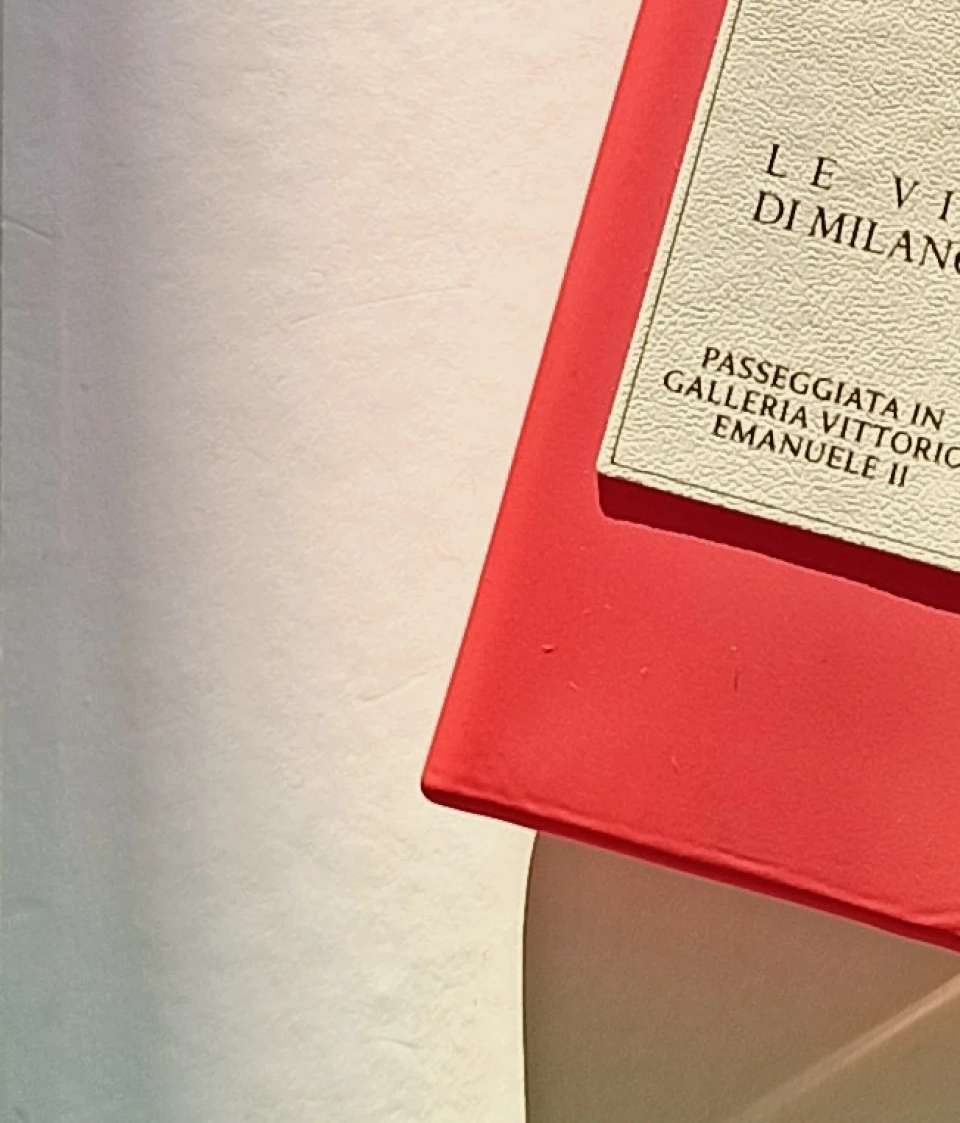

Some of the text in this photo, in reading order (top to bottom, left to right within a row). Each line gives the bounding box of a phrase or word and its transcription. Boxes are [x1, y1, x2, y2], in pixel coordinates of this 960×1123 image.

[763, 144, 837, 190] LE
[753, 190, 801, 231] DI
[663, 370, 807, 428] GALLERIA
[701, 346, 945, 429] PASSEGGIATA IN
[712, 414, 909, 487] EMANUELE II
